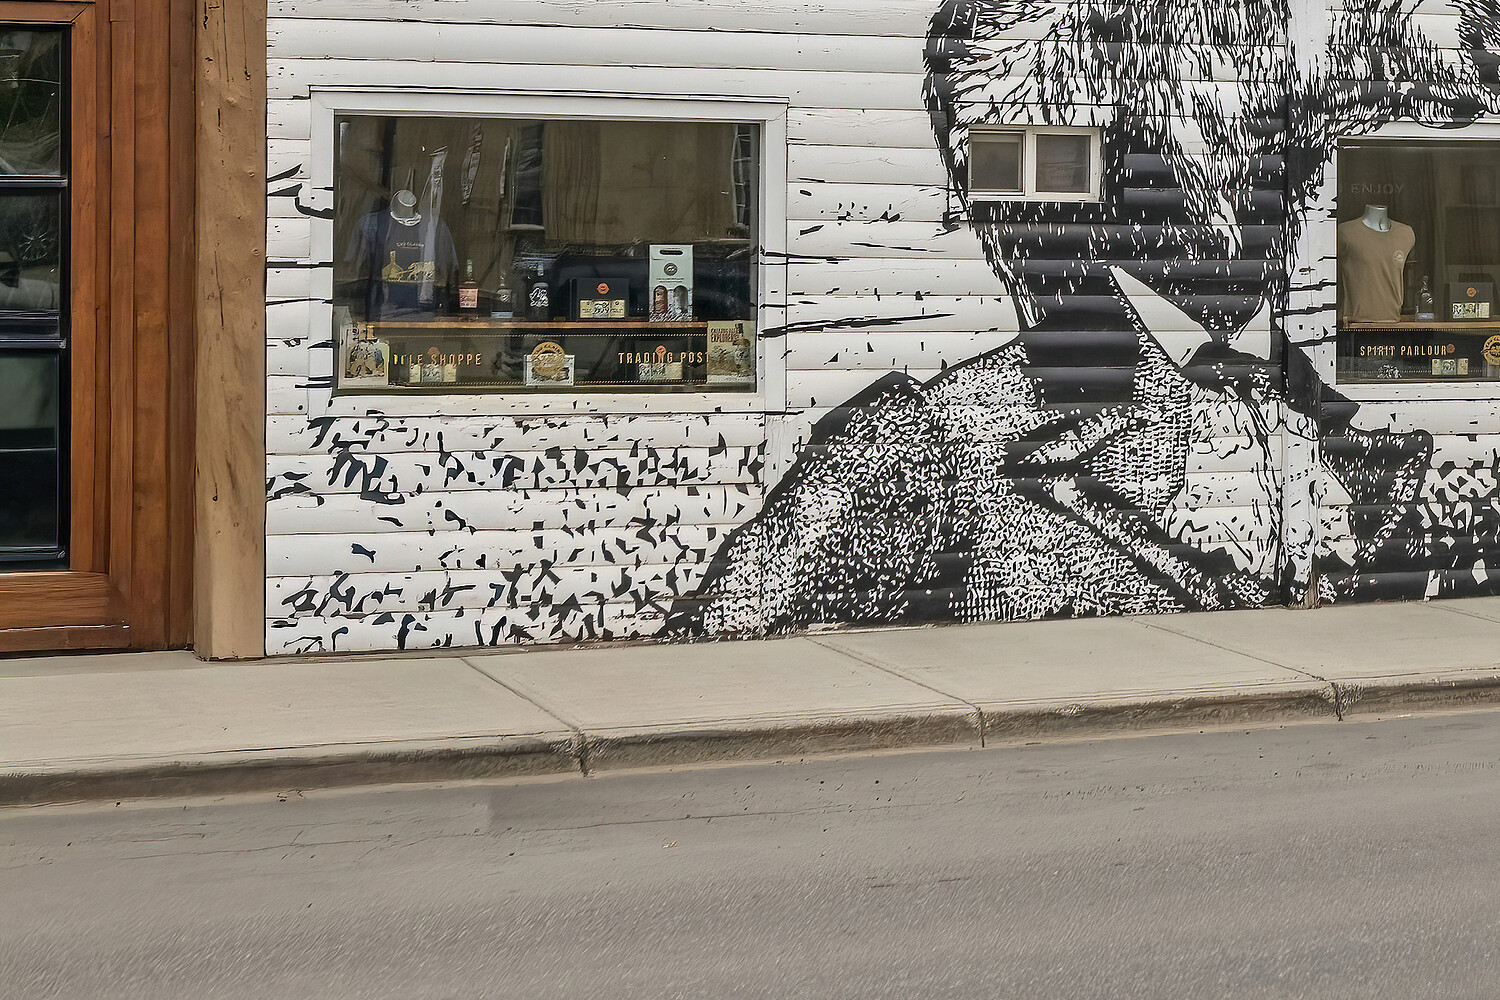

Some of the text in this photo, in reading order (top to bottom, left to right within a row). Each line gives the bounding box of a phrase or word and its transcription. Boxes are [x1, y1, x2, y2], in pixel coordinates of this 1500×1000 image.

[1360, 345, 1447, 356] SPIRIT PARLOUR
[430, 353, 482, 367] SHOPPE
[618, 351, 709, 364] TRADING POST
